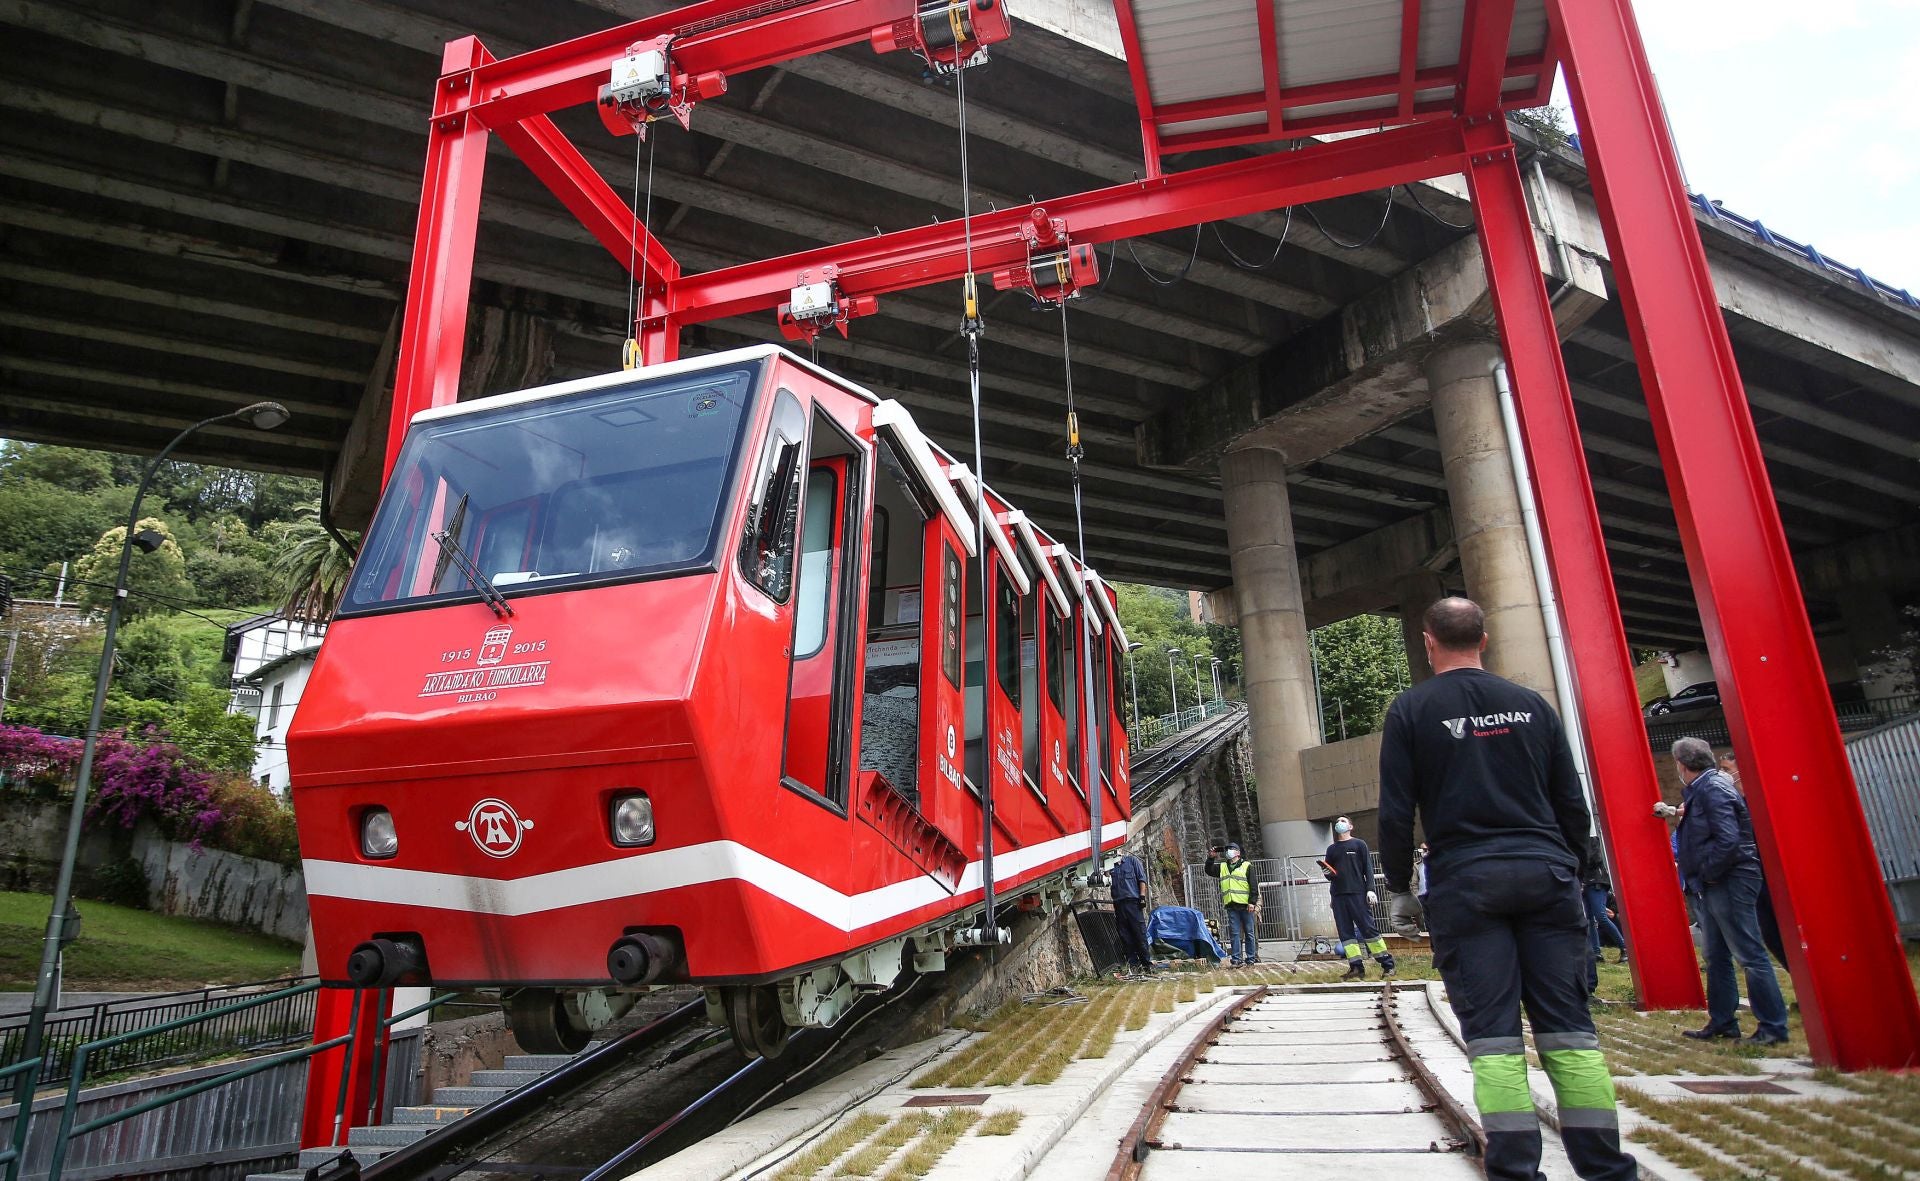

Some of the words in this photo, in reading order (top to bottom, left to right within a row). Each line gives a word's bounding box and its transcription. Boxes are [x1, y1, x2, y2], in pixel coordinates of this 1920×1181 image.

[441, 648, 472, 663] 1915
[513, 639, 547, 654] 2015
[457, 691, 497, 704] BILBAO
[1469, 711, 1532, 728] VICINAY
[939, 753, 961, 791] BILBAO
